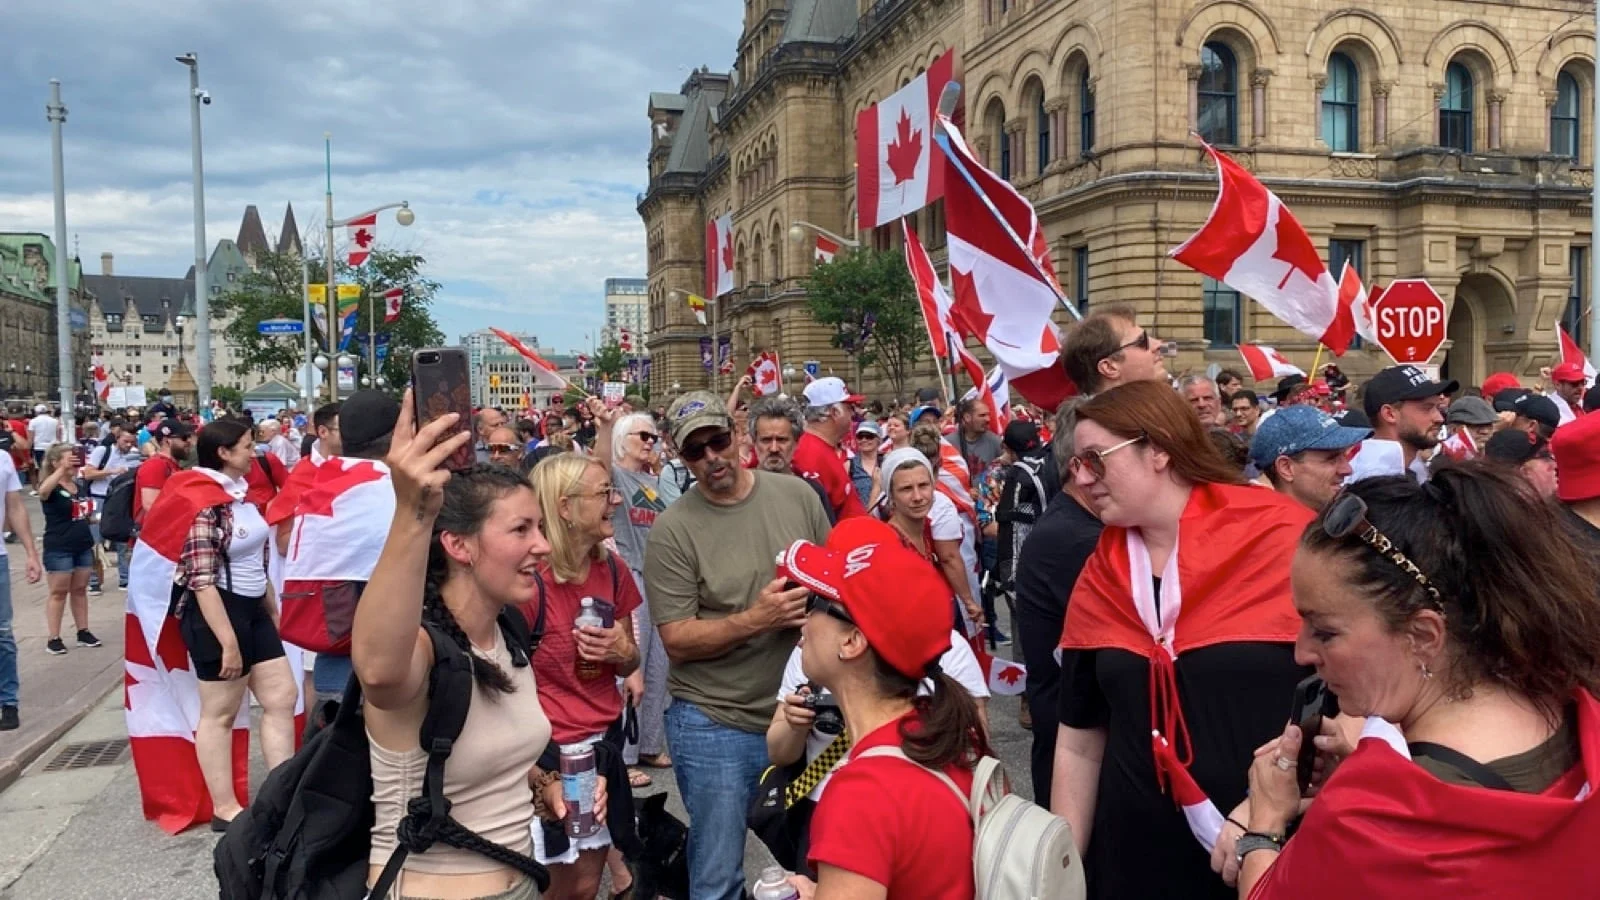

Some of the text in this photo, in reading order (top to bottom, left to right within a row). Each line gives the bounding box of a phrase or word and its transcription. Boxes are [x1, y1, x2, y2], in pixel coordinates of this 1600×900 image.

[1380, 306, 1441, 338] STOP
[629, 506, 658, 528] CAN
[844, 543, 880, 579] DA
